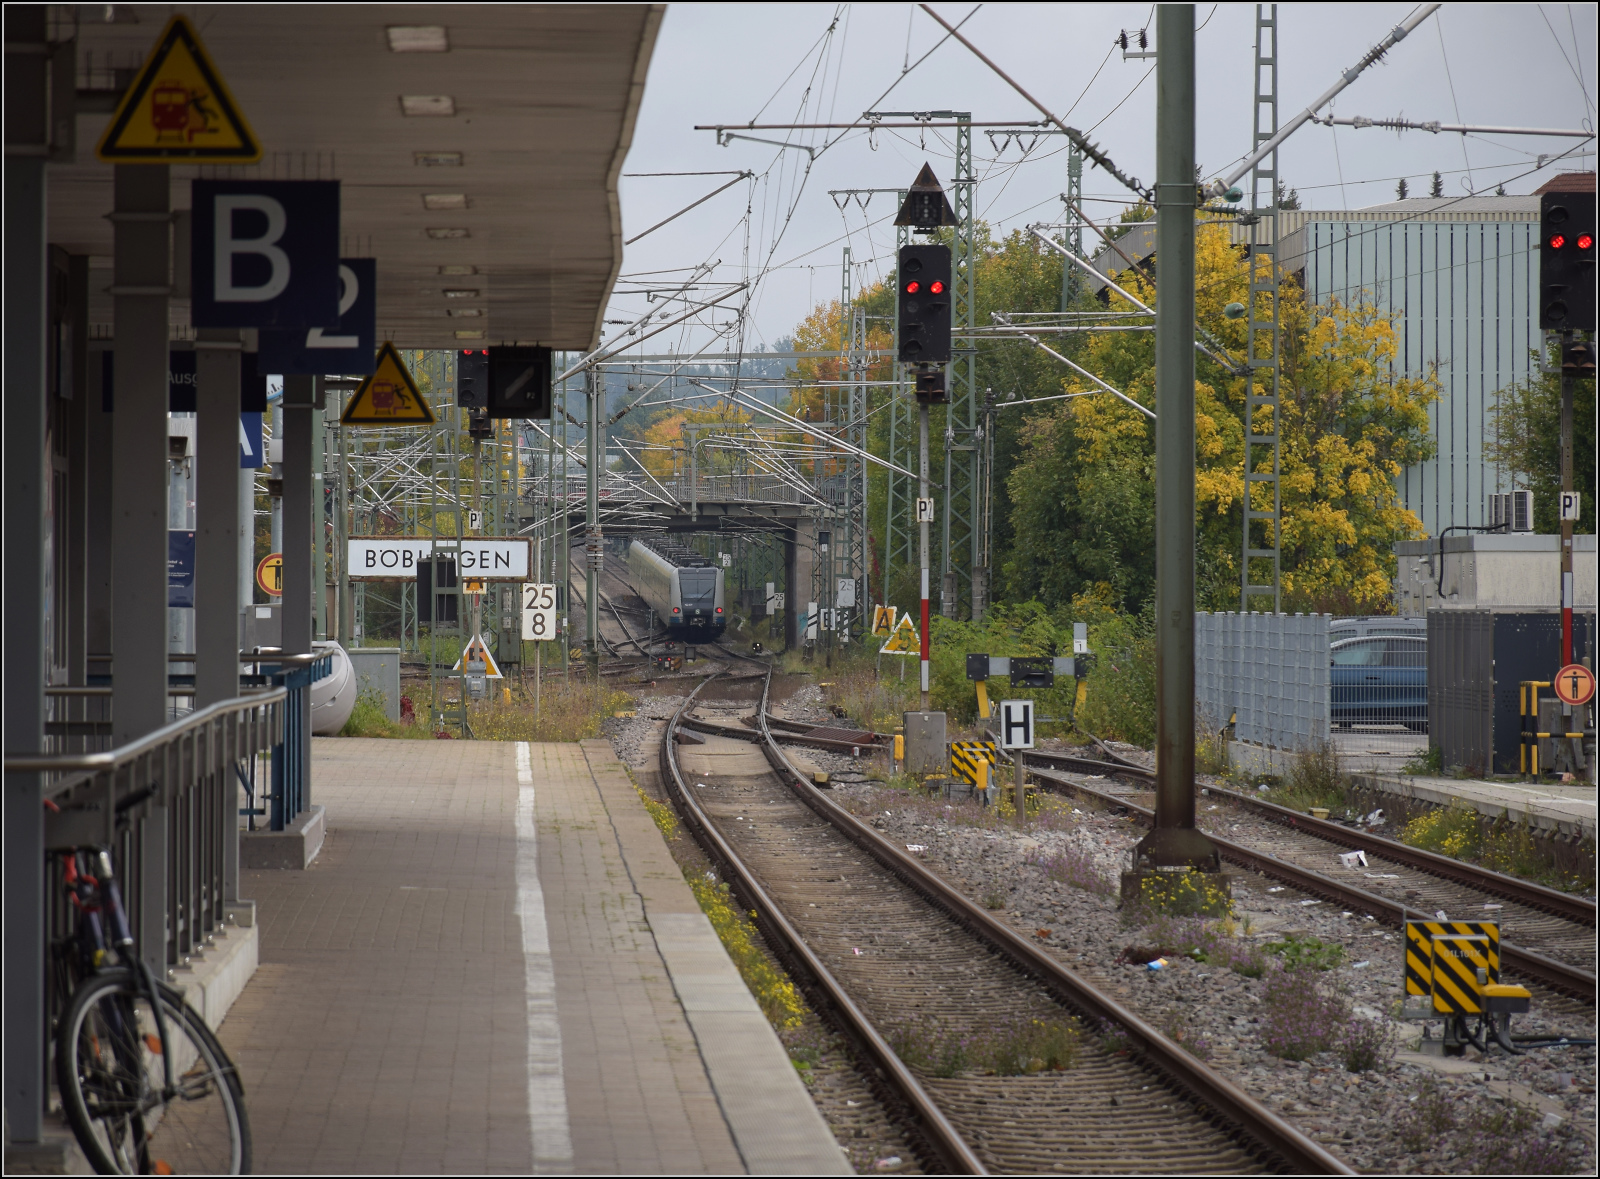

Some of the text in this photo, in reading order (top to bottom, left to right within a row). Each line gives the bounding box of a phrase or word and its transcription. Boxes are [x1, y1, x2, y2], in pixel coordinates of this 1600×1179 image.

[214, 194, 291, 302] B
[305, 264, 359, 348] 2
[918, 500, 933, 520] P2
[1562, 495, 1578, 517] P1
[365, 549, 511, 569] BÖBGEN
[775, 593, 784, 601] 25
[840, 580, 854, 591] 25
[525, 586, 554, 610] 25
[532, 612, 546, 636] 8
[875, 610, 891, 633] A
[1004, 704, 1031, 745] H
